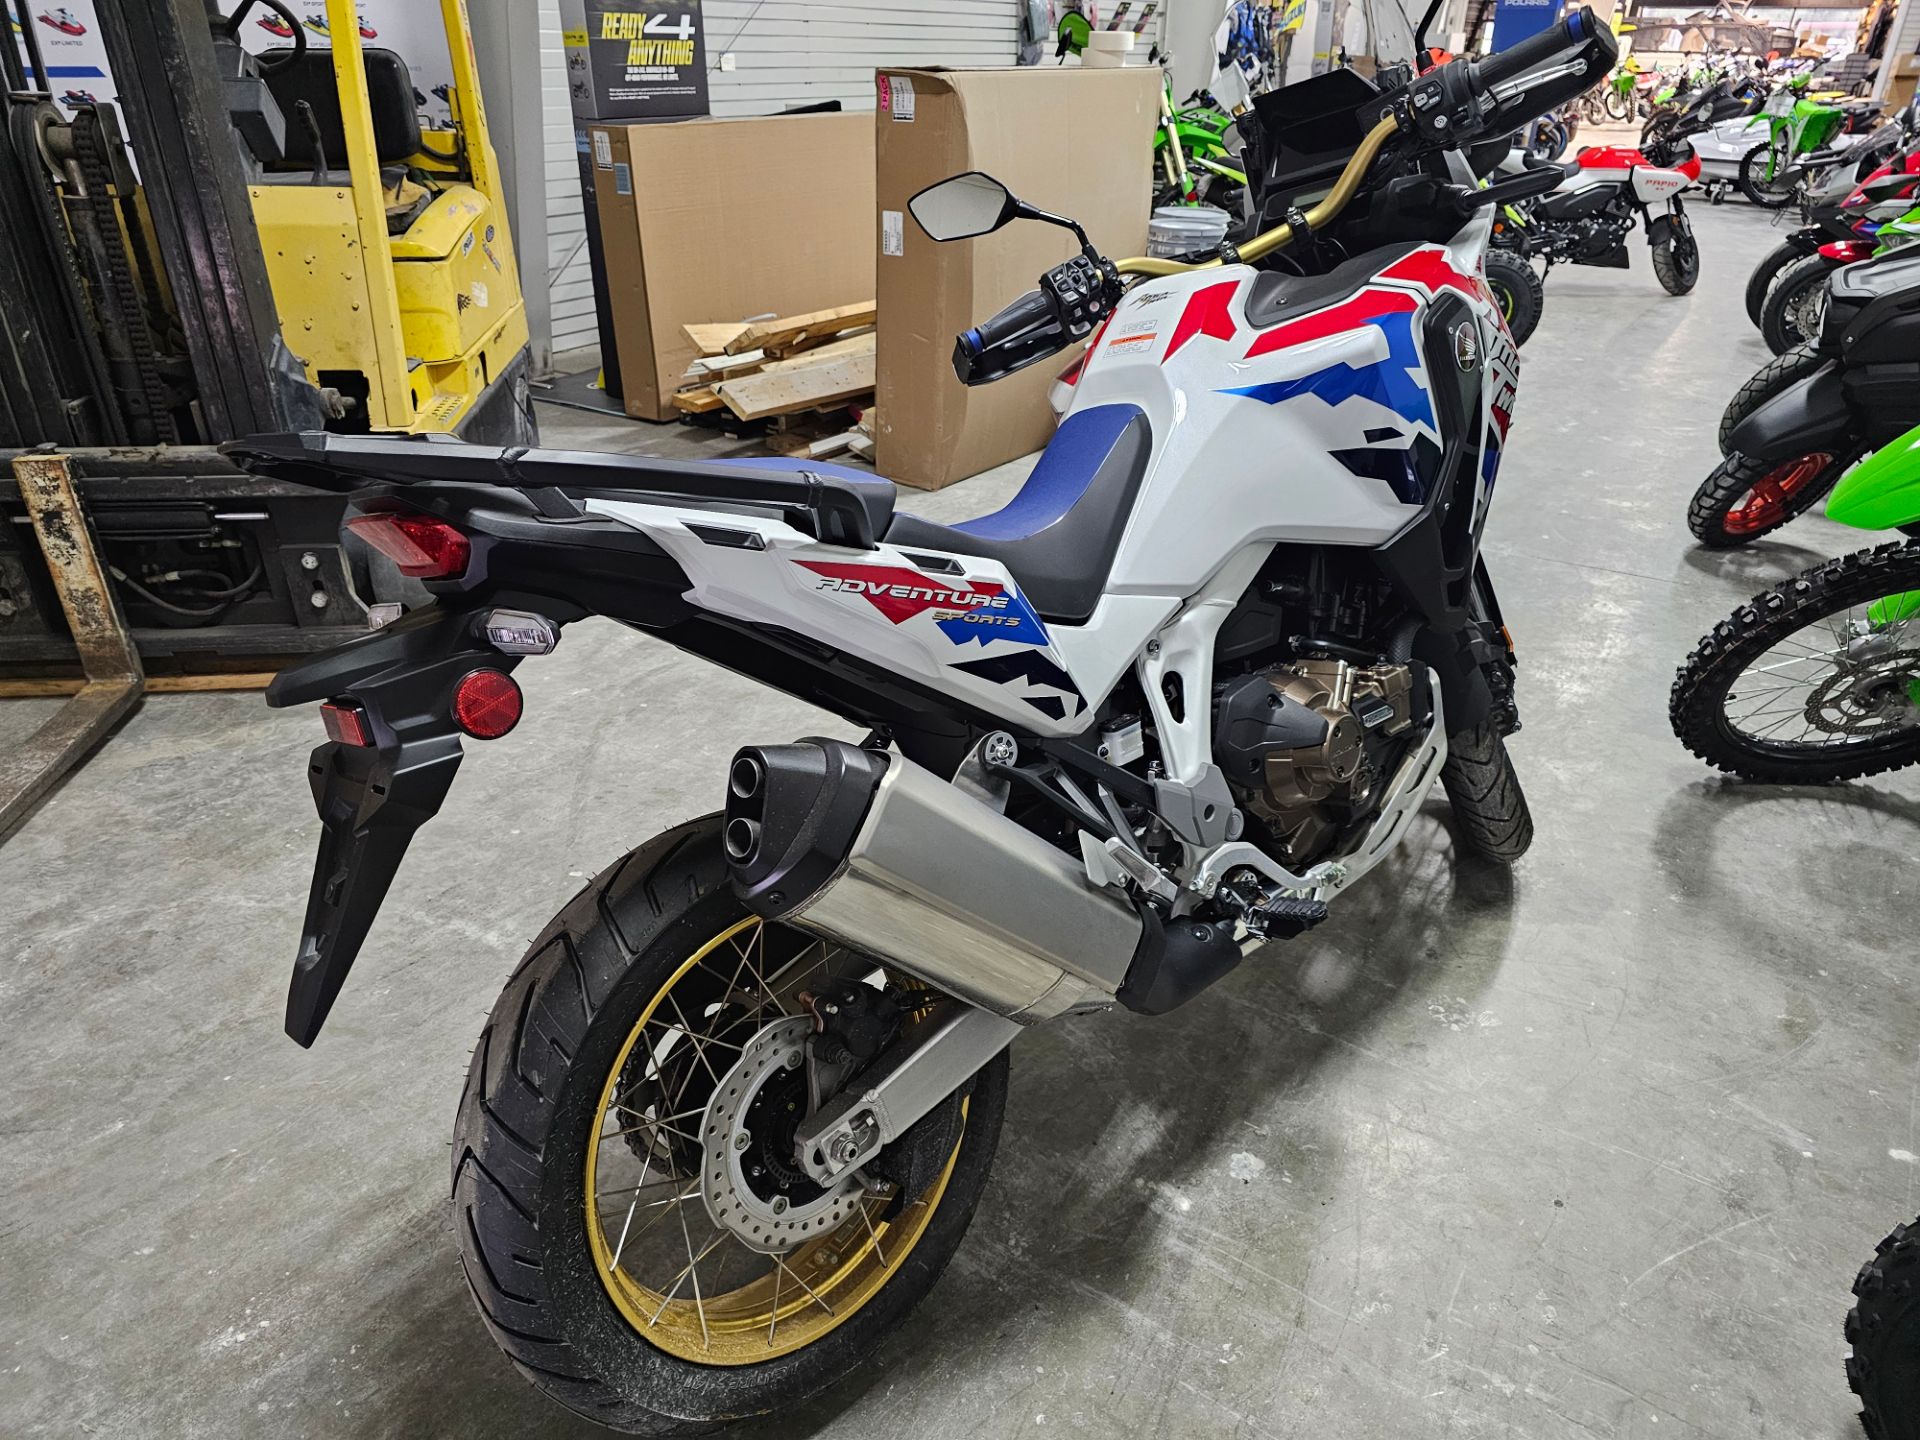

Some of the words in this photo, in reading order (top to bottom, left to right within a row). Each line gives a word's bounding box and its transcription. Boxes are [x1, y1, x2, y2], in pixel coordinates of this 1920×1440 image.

[601, 12, 647, 40] READY
[643, 13, 696, 40] 4
[626, 40, 695, 65] ANYTHING
[816, 578, 1010, 608] ADVENTURE
[932, 610, 1021, 628] SPORTS
